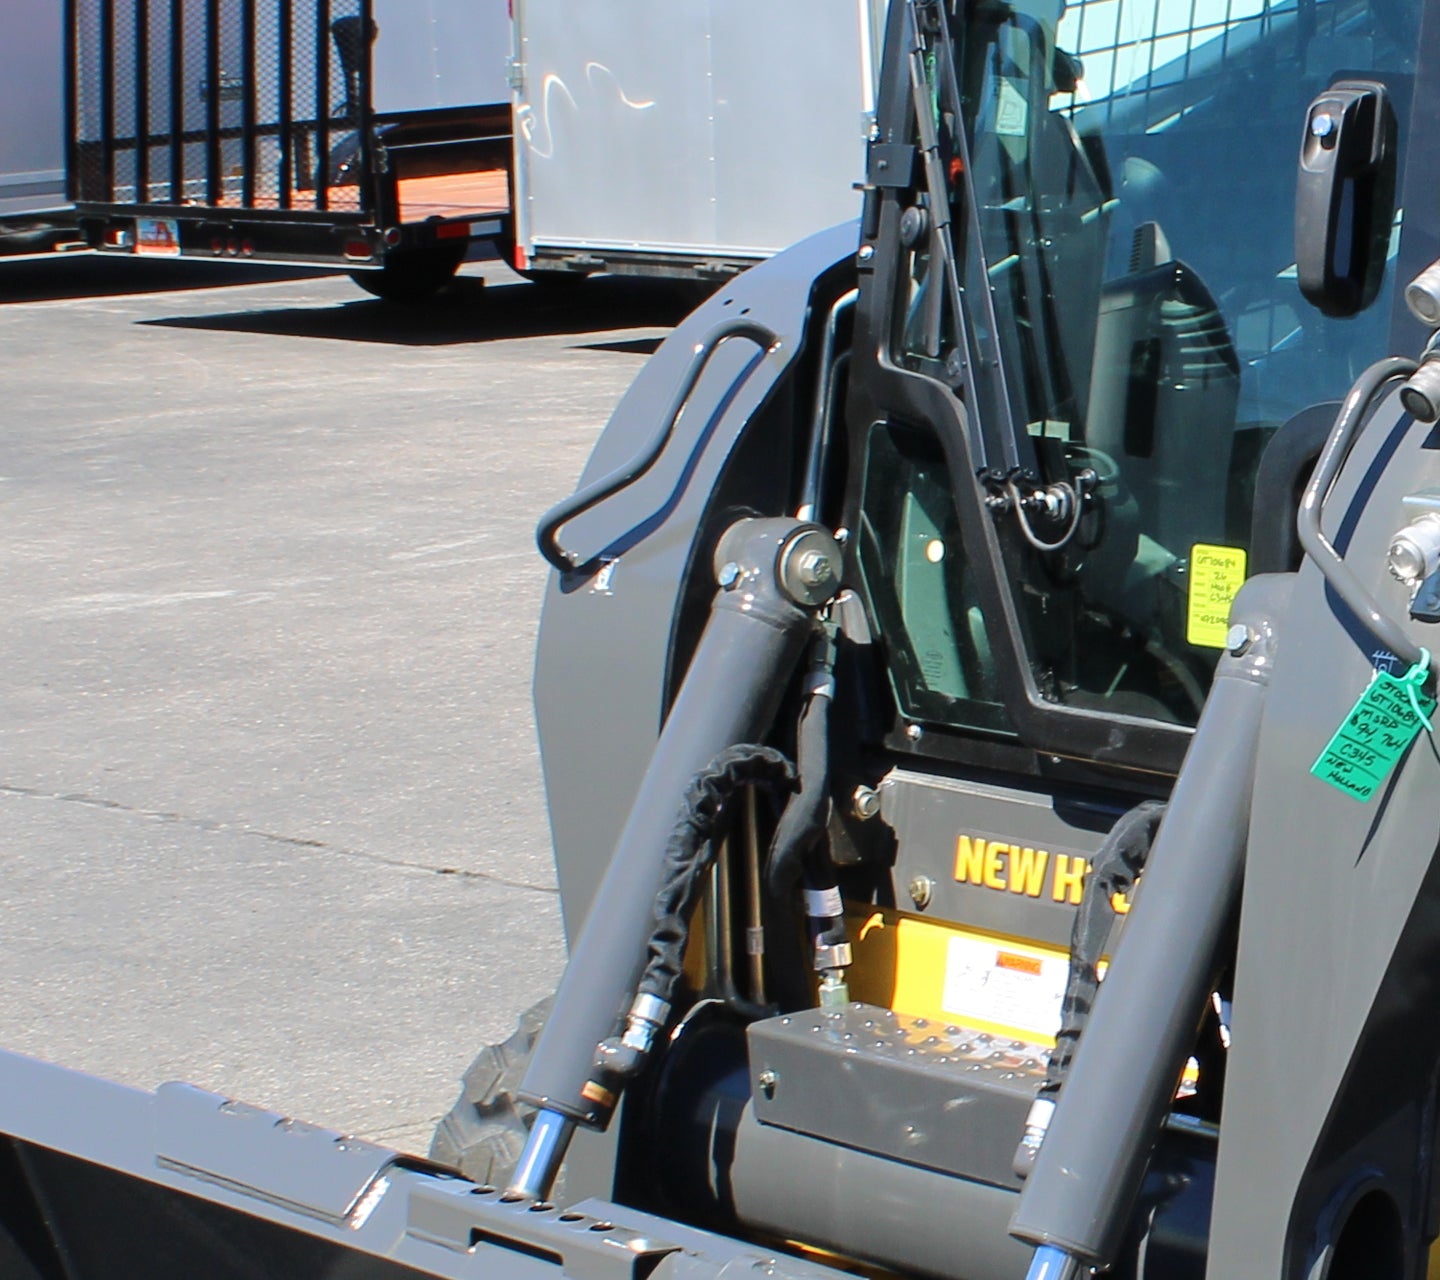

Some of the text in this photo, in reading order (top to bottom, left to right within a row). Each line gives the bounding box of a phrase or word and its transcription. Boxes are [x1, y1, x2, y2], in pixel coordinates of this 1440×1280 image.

[1360, 708, 1398, 729] MSRP
[1325, 757, 1353, 773] NEW
[1340, 743, 1376, 766] C345
[954, 834, 1049, 898] NEW
